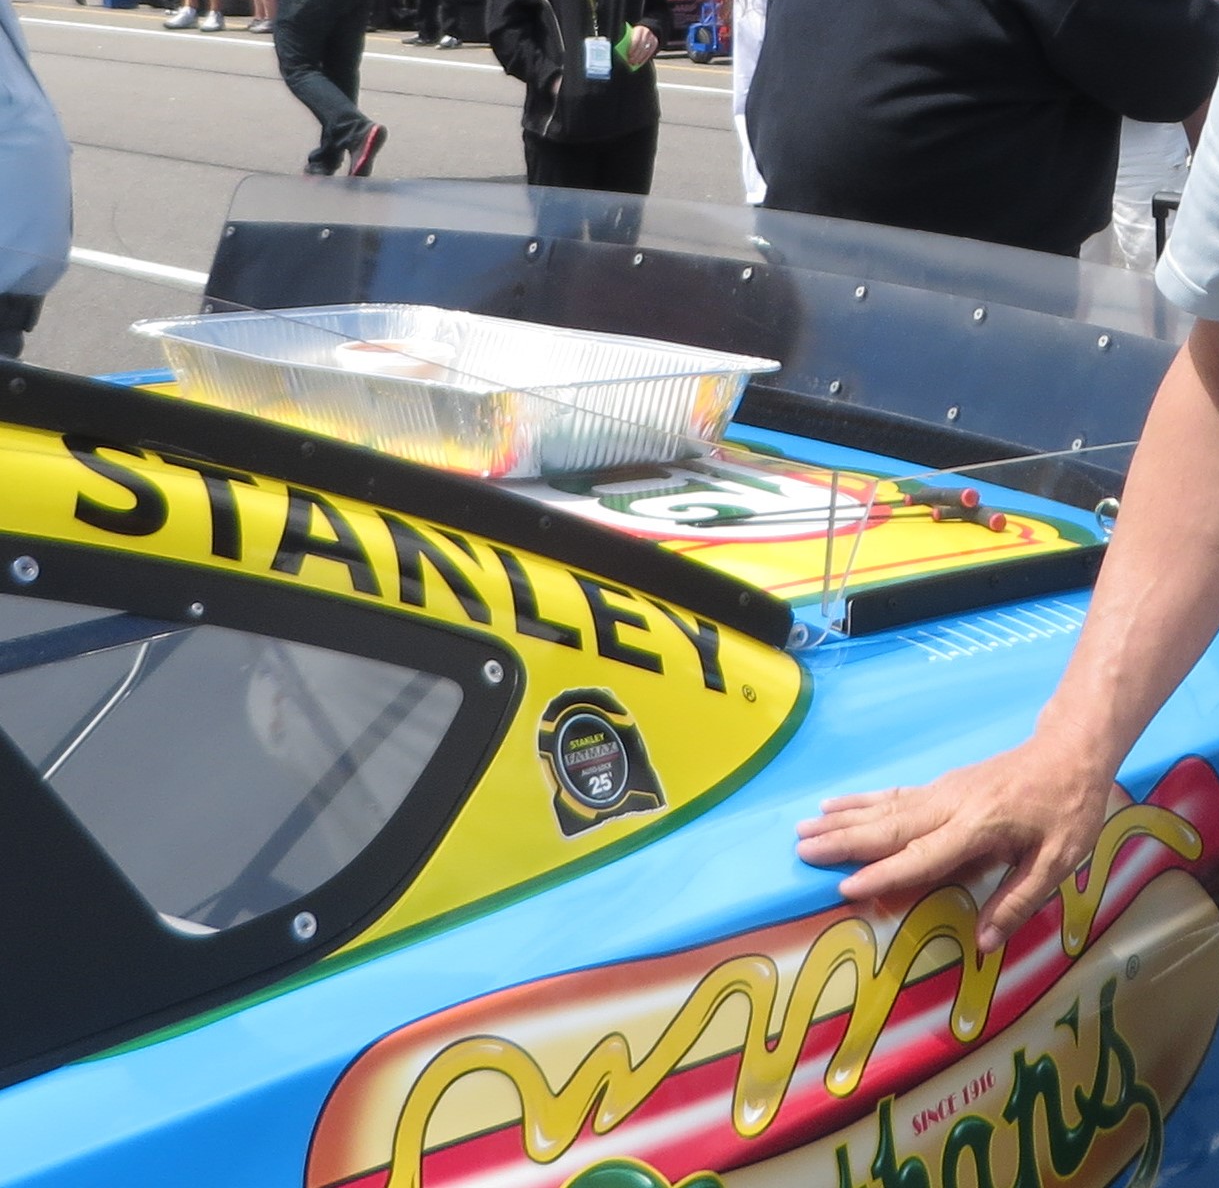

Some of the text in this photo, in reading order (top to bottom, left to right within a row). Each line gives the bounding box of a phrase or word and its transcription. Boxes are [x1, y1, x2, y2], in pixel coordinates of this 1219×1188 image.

[62, 432, 728, 694] STANLEY
[564, 741, 619, 766] FATMAX
[569, 732, 605, 750] STANLEY
[911, 1068, 998, 1137] SINCE 1916
